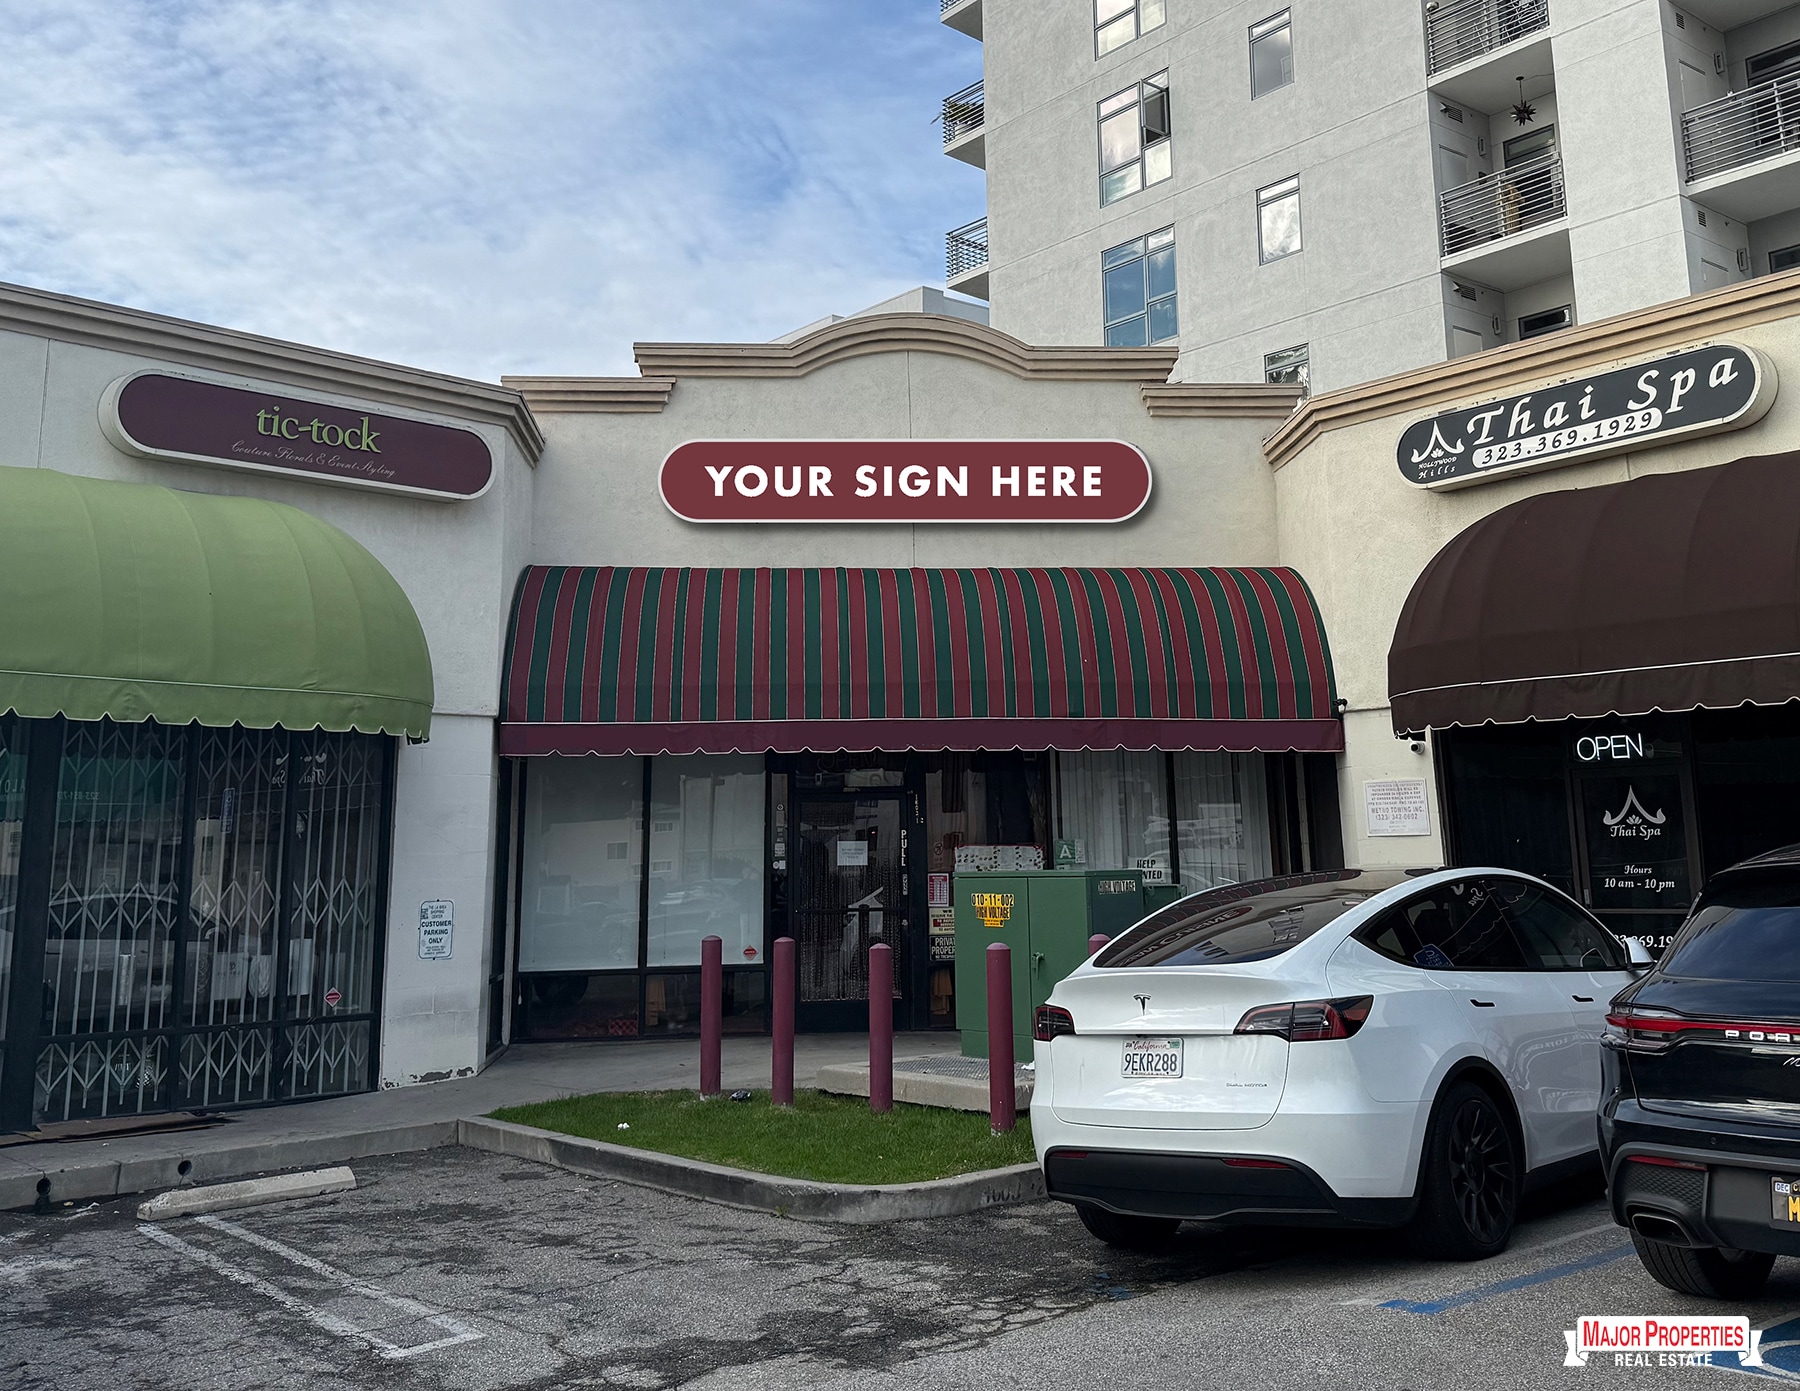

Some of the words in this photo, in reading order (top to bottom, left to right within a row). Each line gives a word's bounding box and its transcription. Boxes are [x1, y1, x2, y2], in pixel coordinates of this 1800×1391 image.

[1466, 384, 1596, 446] Thai
[1626, 357, 1739, 414] Spa
[256, 405, 382, 453] tic-tock
[1481, 411, 1652, 465] 323.369.1929
[231, 439, 272, 457] Couture
[275, 446, 313, 464] Florals
[315, 452, 326, 466] &
[327, 455, 357, 469] Event
[356, 460, 396, 479] Styling
[1418, 465, 1456, 479] Hills
[704, 464, 834, 498] YOUR
[854, 464, 968, 498] SIGN
[991, 465, 1102, 497] HERE
[1576, 732, 1643, 761] OPEN
[1610, 824, 1636, 838] Thai
[1639, 824, 1661, 840] Spa
[1060, 844, 1073, 859] A
[1136, 859, 1156, 869] HELP
[1623, 864, 1652, 875] Hours
[1604, 878, 1616, 888] 10
[1617, 880, 1635, 888] am
[1644, 878, 1657, 889] 10
[1656, 881, 1675, 893] pm
[988, 906, 1010, 919] VOLTAGE
[421, 920, 452, 928] CUSTOMER
[1124, 1053, 1178, 1072] 9EKR288
[1776, 1183, 1789, 1192] DEC
